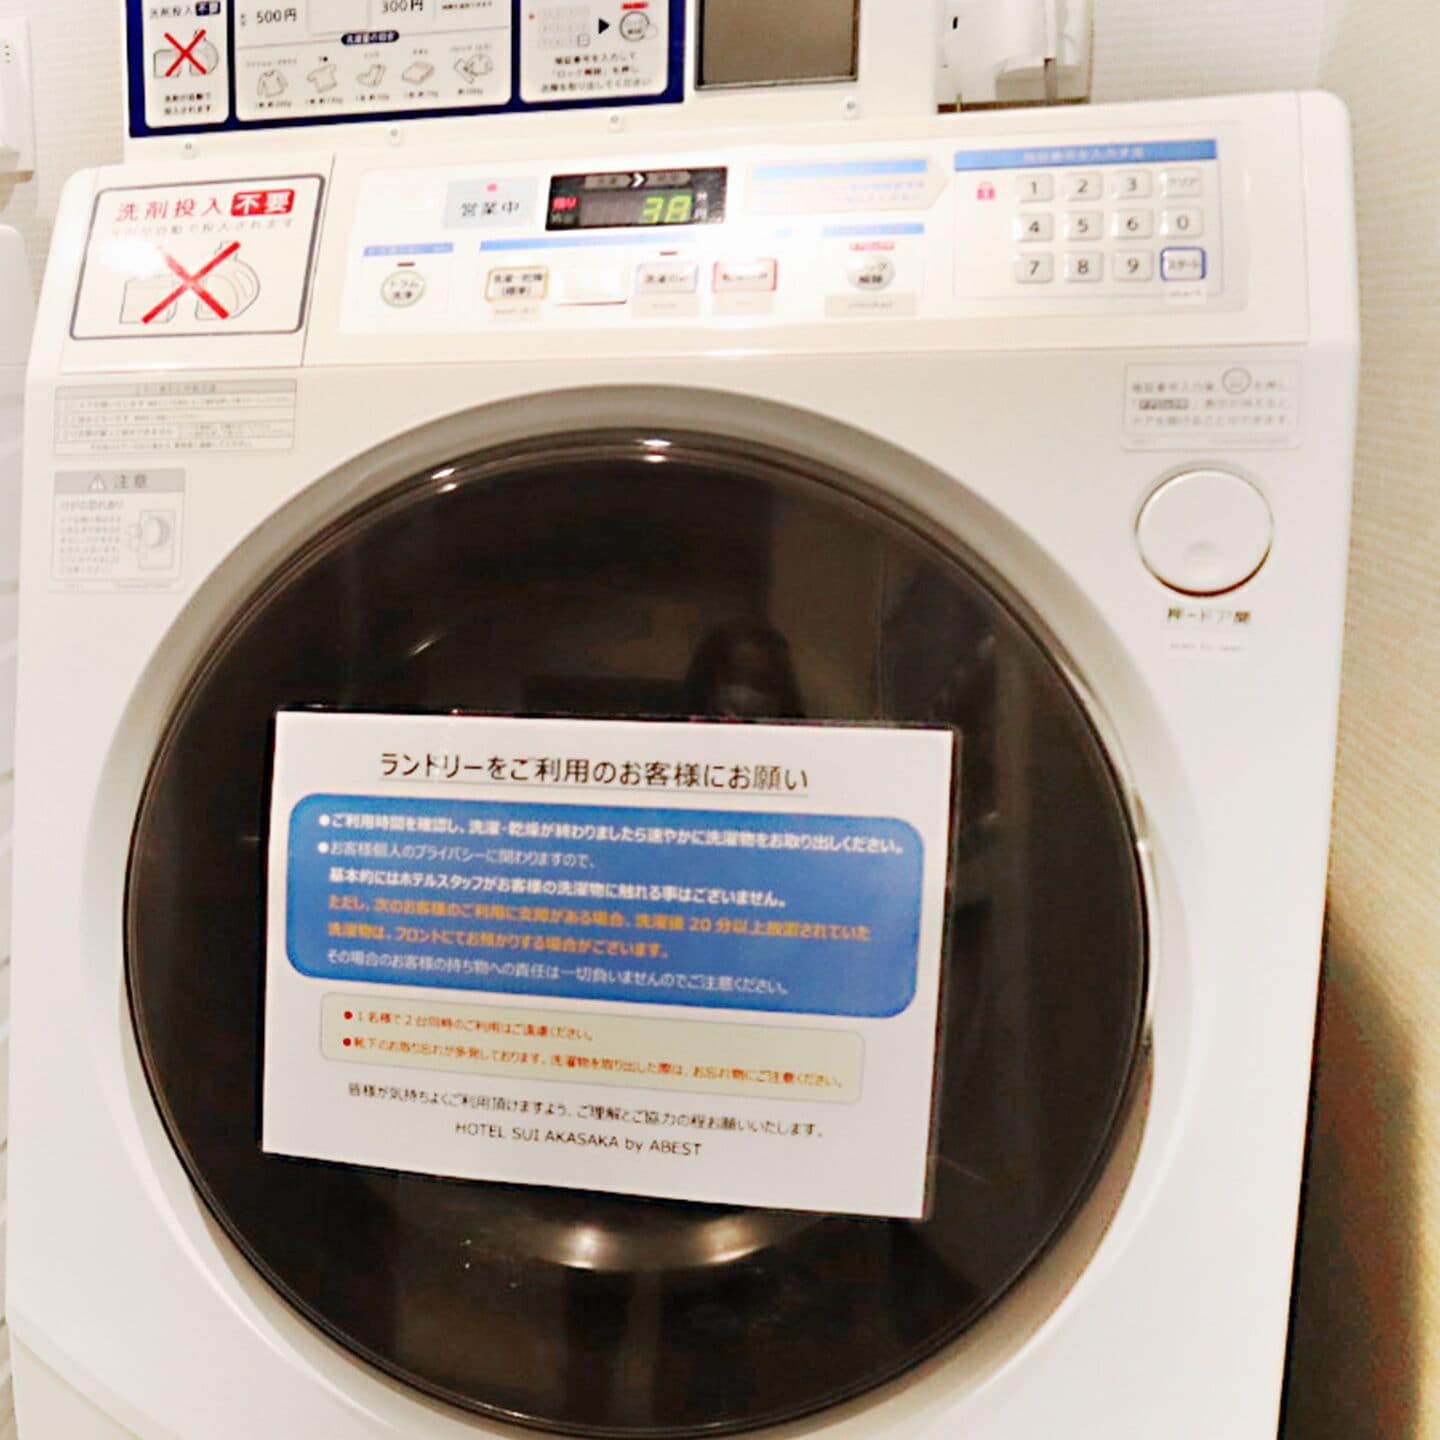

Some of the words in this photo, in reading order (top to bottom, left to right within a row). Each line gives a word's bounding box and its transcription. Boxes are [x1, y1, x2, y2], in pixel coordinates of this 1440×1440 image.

[255, 8, 297, 24] 500円
[1030, 180, 1038, 194] 1
[1076, 178, 1089, 194] 2
[1126, 177, 1138, 192] 3
[115, 196, 224, 222] 洗剤投入
[233, 190, 293, 216] 不要
[460, 199, 520, 218] 営業中
[641, 194, 692, 225] 38
[1028, 220, 1040, 234] 4
[1077, 218, 1089, 233] 5
[1126, 215, 1139, 232] 6
[1176, 214, 1190, 231] 0
[1029, 260, 1040, 275] 7
[1077, 258, 1090, 275] 8
[1127, 257, 1140, 274] 9
[455, 1122, 505, 1139] HOTEL
[511, 1127, 540, 1142] SUI
[545, 1129, 619, 1148] AKASAKA
[624, 1136, 643, 1153] by
[649, 1140, 703, 1157] ABEST
